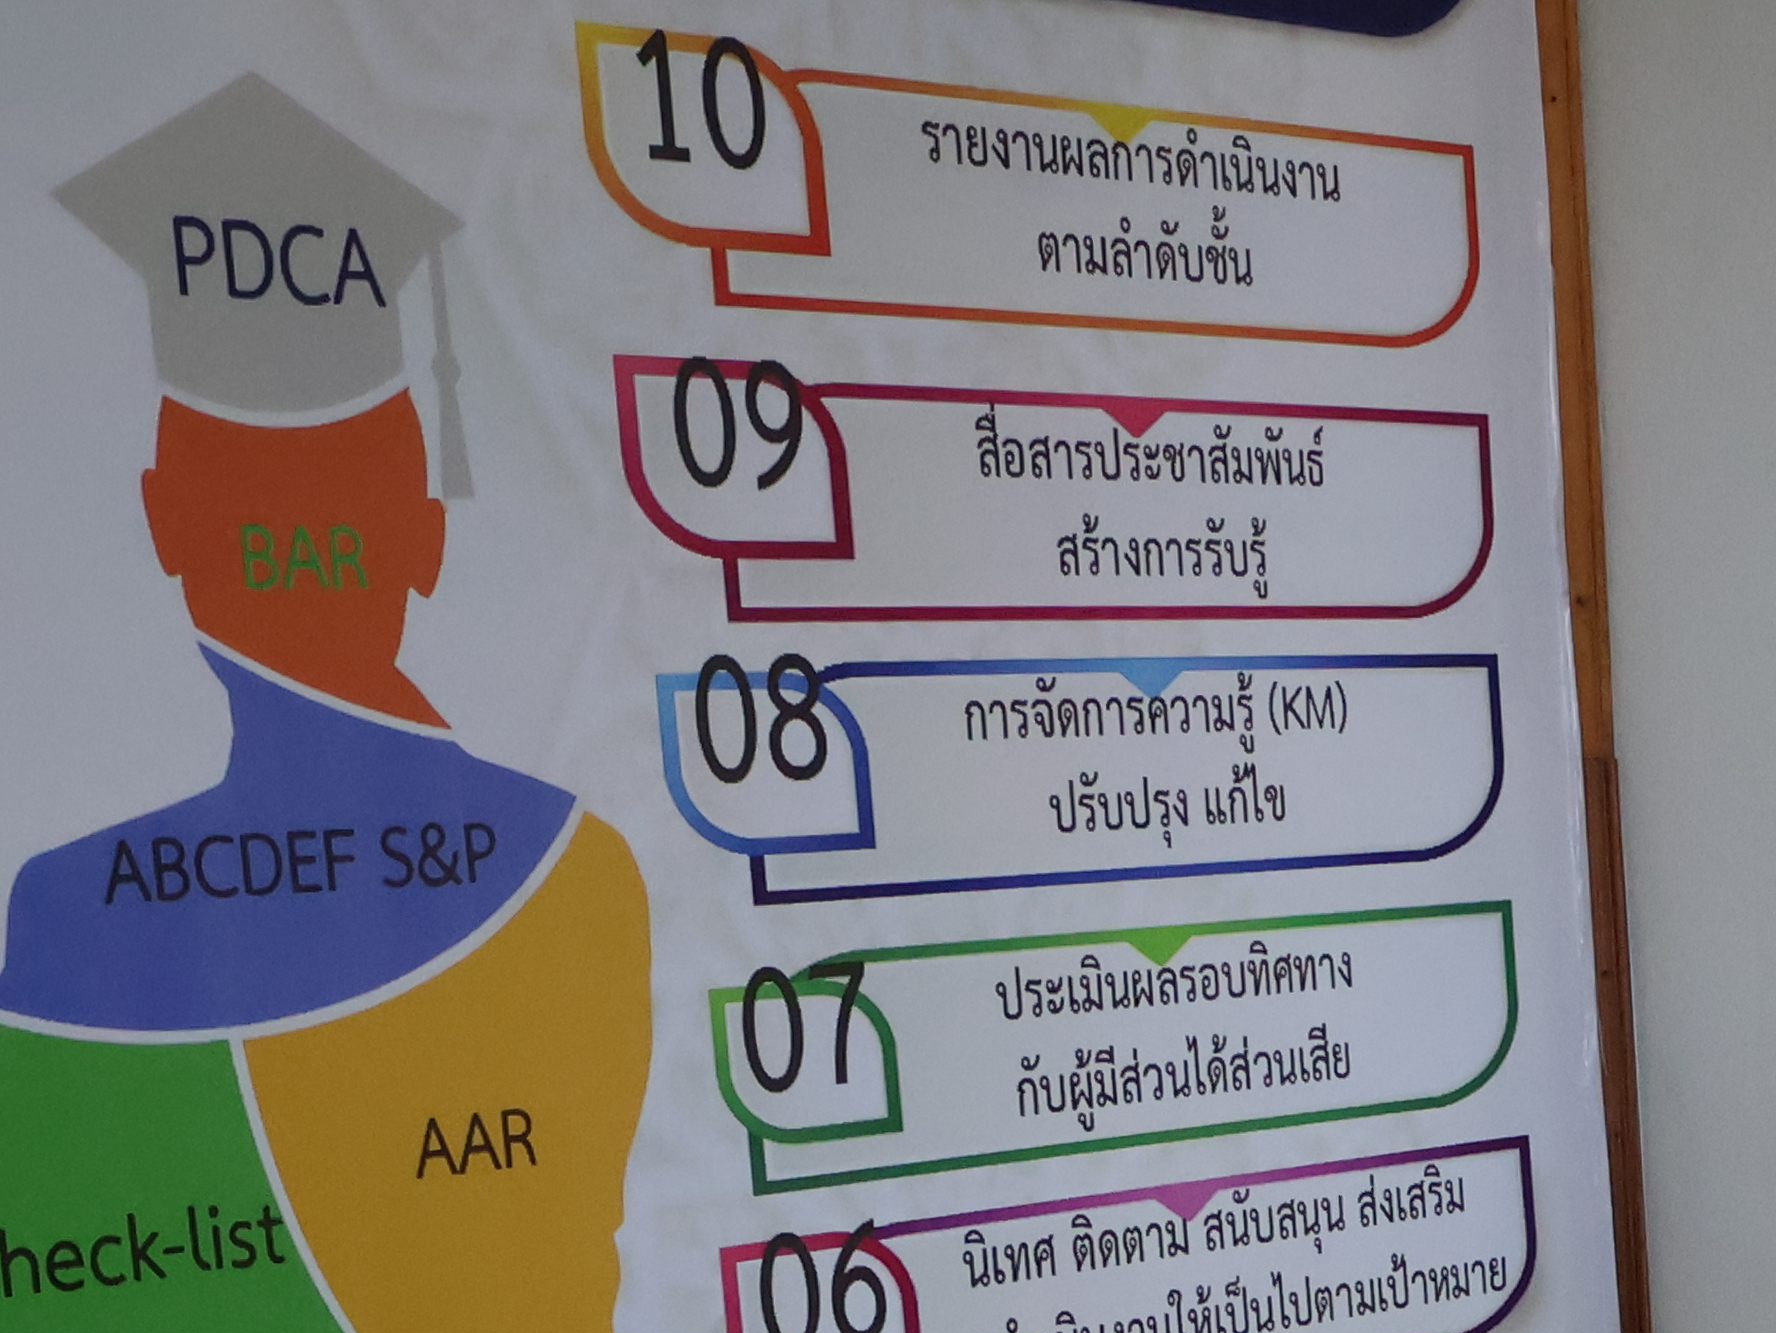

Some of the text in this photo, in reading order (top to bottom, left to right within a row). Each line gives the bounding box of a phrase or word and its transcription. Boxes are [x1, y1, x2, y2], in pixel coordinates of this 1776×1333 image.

[636, 29, 766, 170] 10
[921, 117, 1341, 202] รายงานผลการดำเนินงาน
[174, 216, 386, 307] PDCA
[1037, 207, 1253, 287] ตามลำดับชั้น
[673, 357, 804, 490] 09
[976, 402, 1325, 486] สื่อสารประชาสัมพันธ์
[241, 524, 369, 591] BAR
[1058, 513, 1269, 599] สร้างการรับรู้
[696, 653, 827, 783] 08
[965, 672, 1347, 753] การจัดการความรู้ (KM)
[1049, 763, 1287, 849] ปรับปรุง แก้ไข
[104, 822, 496, 905] ABCDEF S&P
[996, 942, 1354, 1021] ประเมินผลรอบทิศทาง
[742, 961, 866, 1093] 07
[1017, 1023, 1352, 1132] กับผู้มีส่วนได้ส่วนเสีย
[415, 1108, 538, 1180] AAR
[0, 1205, 286, 1297] heck-list
[964, 1164, 1466, 1290] นิเทศ ติดตาม สนับสนุน ส่งเสริม
